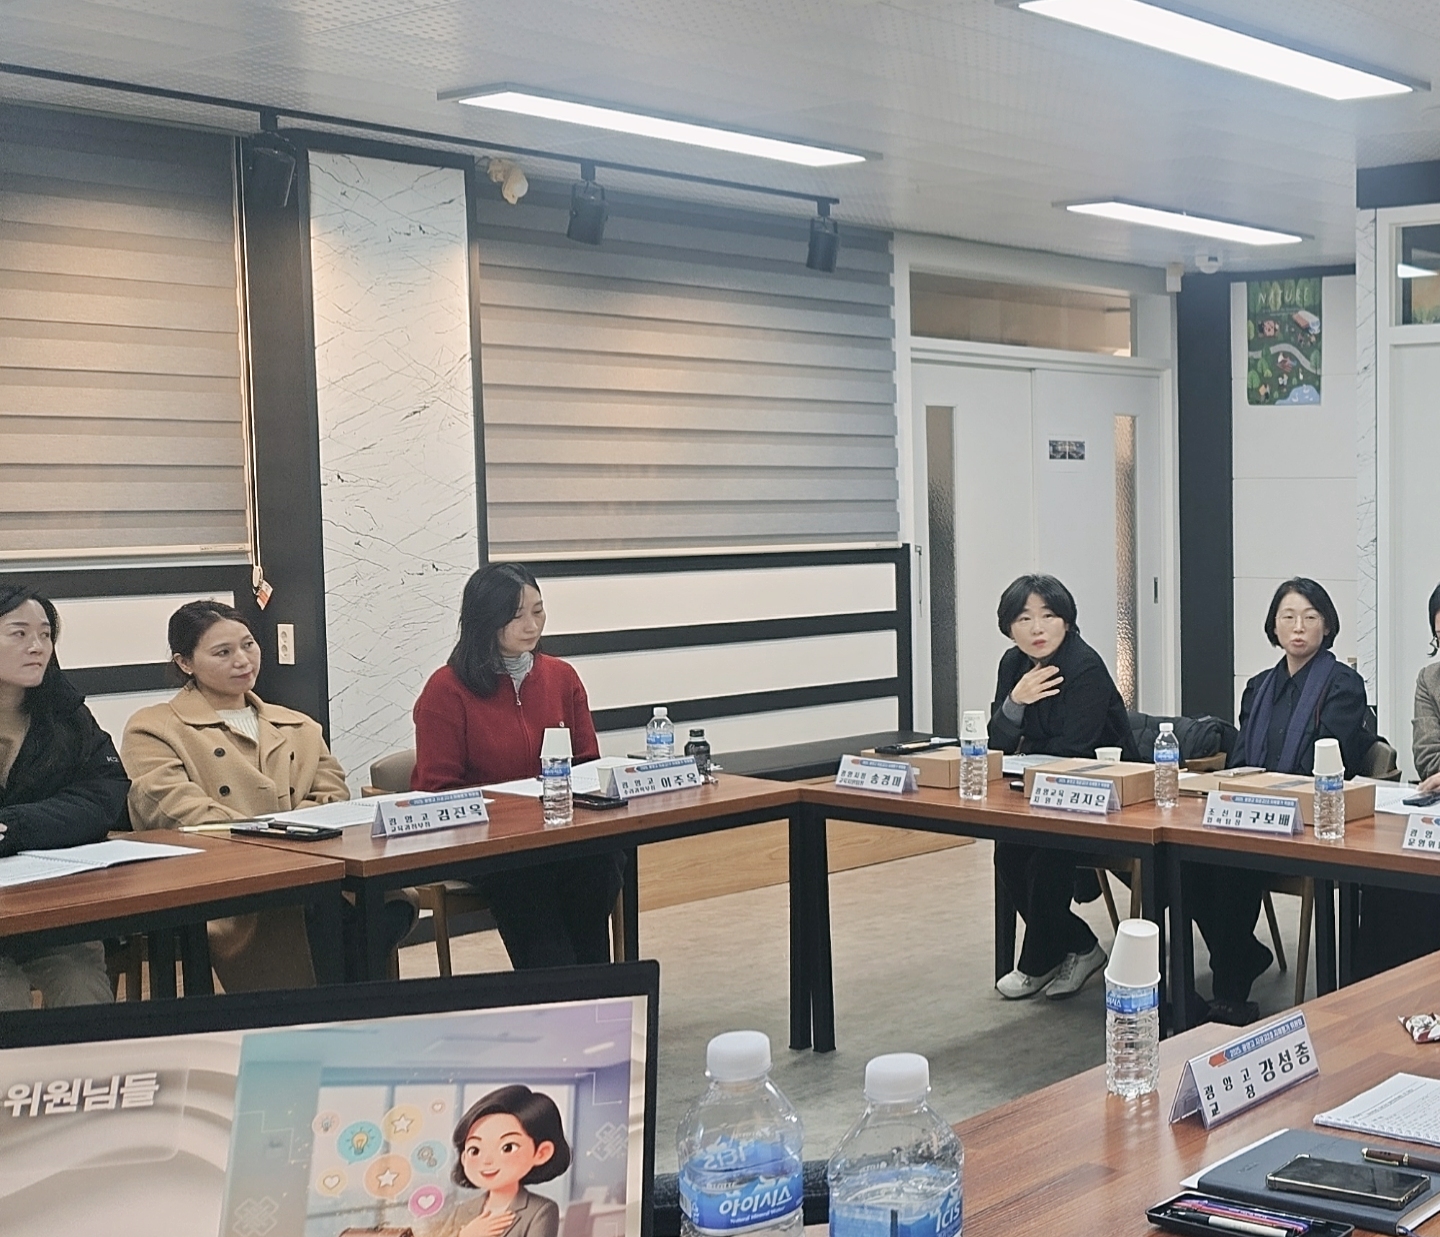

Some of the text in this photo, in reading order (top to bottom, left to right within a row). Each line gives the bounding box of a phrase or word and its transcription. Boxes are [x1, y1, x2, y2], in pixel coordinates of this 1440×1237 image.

[1257, 286, 1309, 305] NATURE
[660, 772, 698, 788] 이주옥
[870, 773, 902, 788] 송경미
[1069, 792, 1106, 807] 김지은
[436, 803, 483, 822] 김진옥
[1208, 808, 1291, 827] 조선대 구보배
[1203, 1041, 1311, 1101] 광양고 강성종
[3, 1072, 160, 1118] 위원님들
[718, 1185, 793, 1218] 아이시스
[935, 1200, 961, 1233] ICIS
